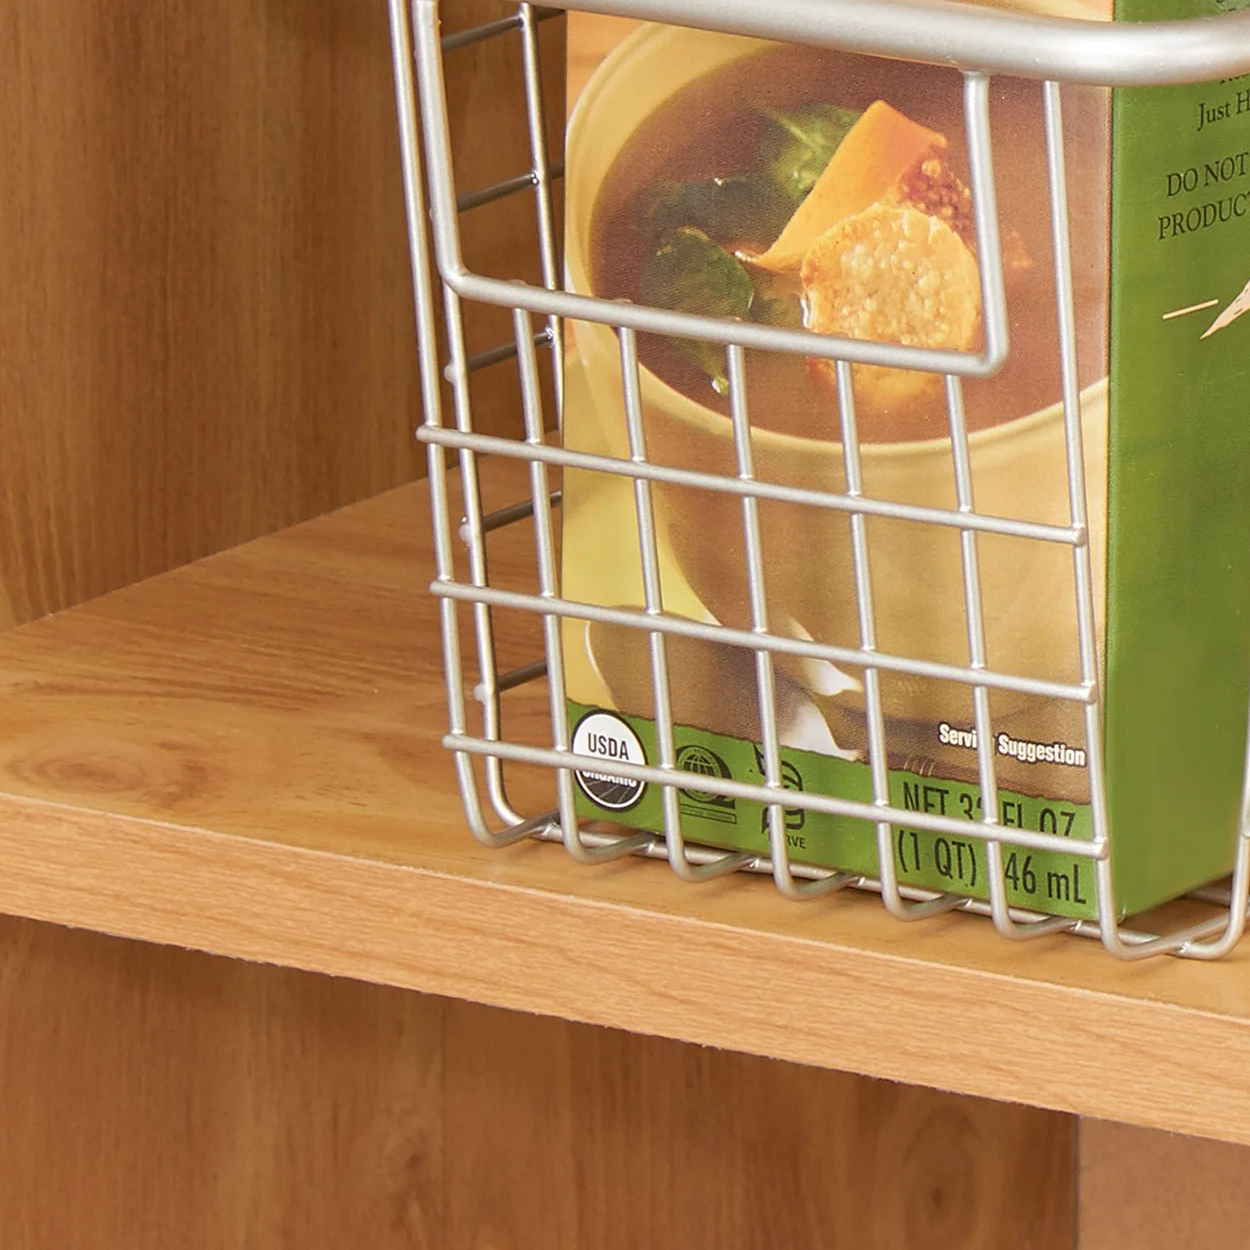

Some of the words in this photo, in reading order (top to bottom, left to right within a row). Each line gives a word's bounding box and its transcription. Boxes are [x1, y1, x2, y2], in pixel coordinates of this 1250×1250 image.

[1197, 103, 1231, 132] Just
[1166, 168, 1198, 198] DO
[1203, 152, 1249, 187] NOT
[588, 732, 629, 760] USDA
[938, 723, 988, 753] Servi
[998, 734, 1087, 767] Suggestion
[959, 792, 983, 821] 3
[898, 830, 920, 873] (1
[934, 837, 976, 887] QT)
[1004, 852, 1037, 895] 46
[1047, 864, 1087, 905] mL
